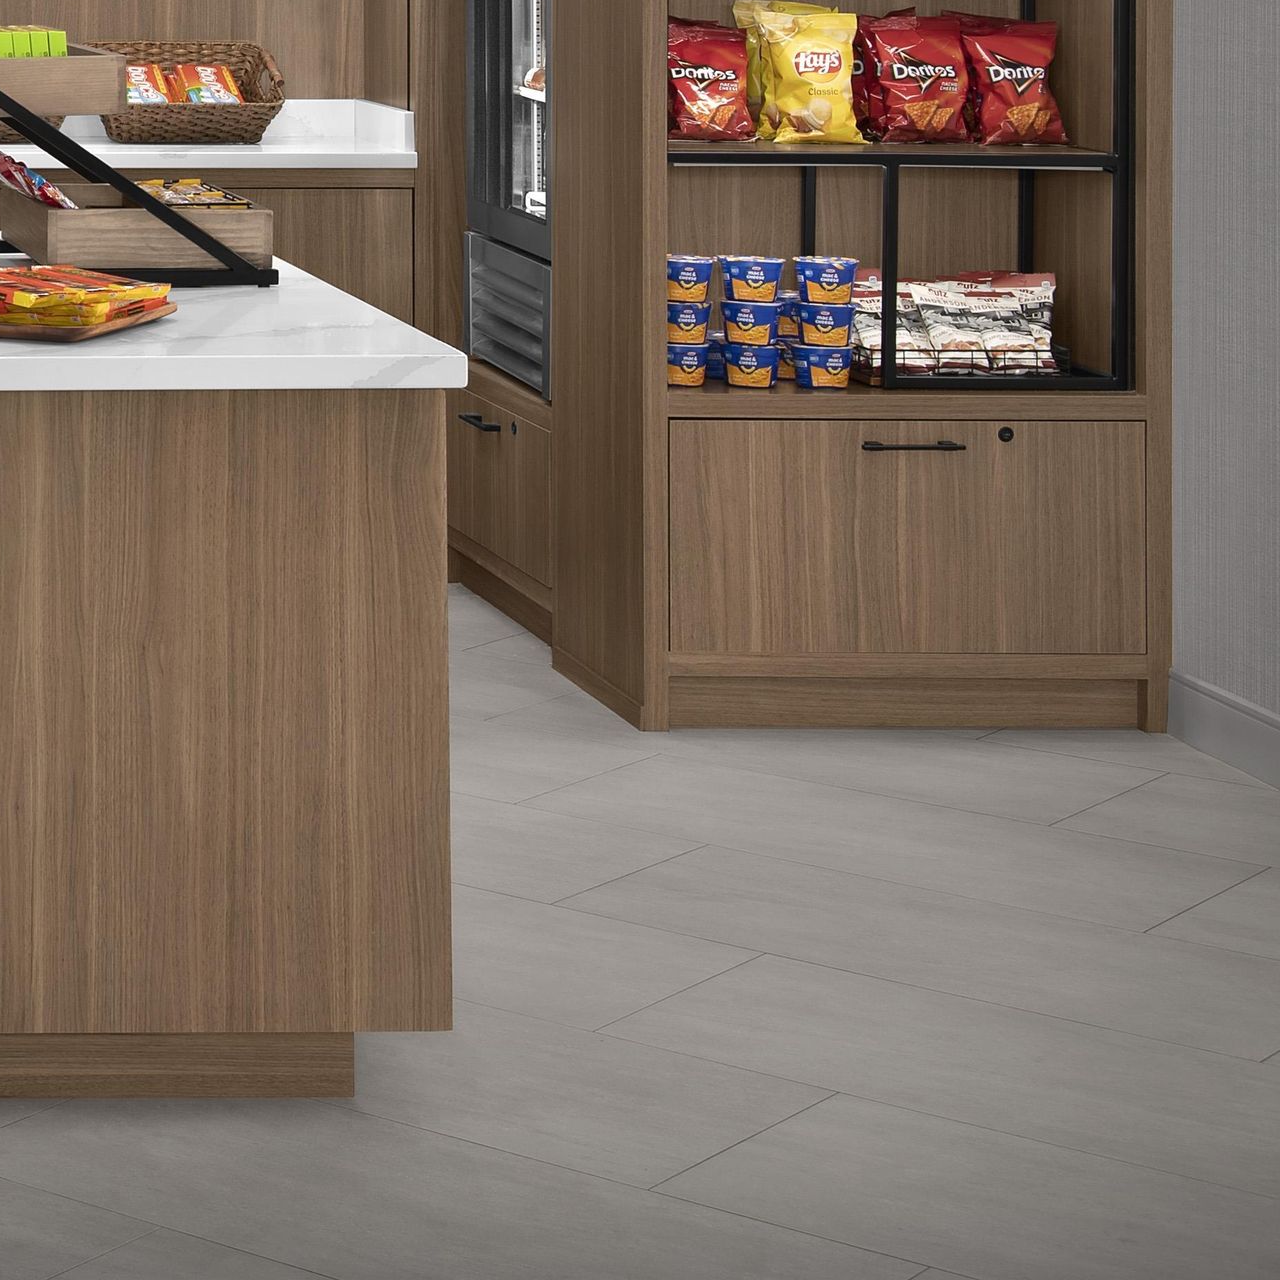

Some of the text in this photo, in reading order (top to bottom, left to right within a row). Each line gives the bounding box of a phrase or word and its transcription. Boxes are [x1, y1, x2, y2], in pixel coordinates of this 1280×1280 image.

[799, 50, 840, 75] Lay's
[671, 67, 736, 80] Doritos
[893, 64, 956, 80] Doritos
[808, 87, 839, 96] Classic
